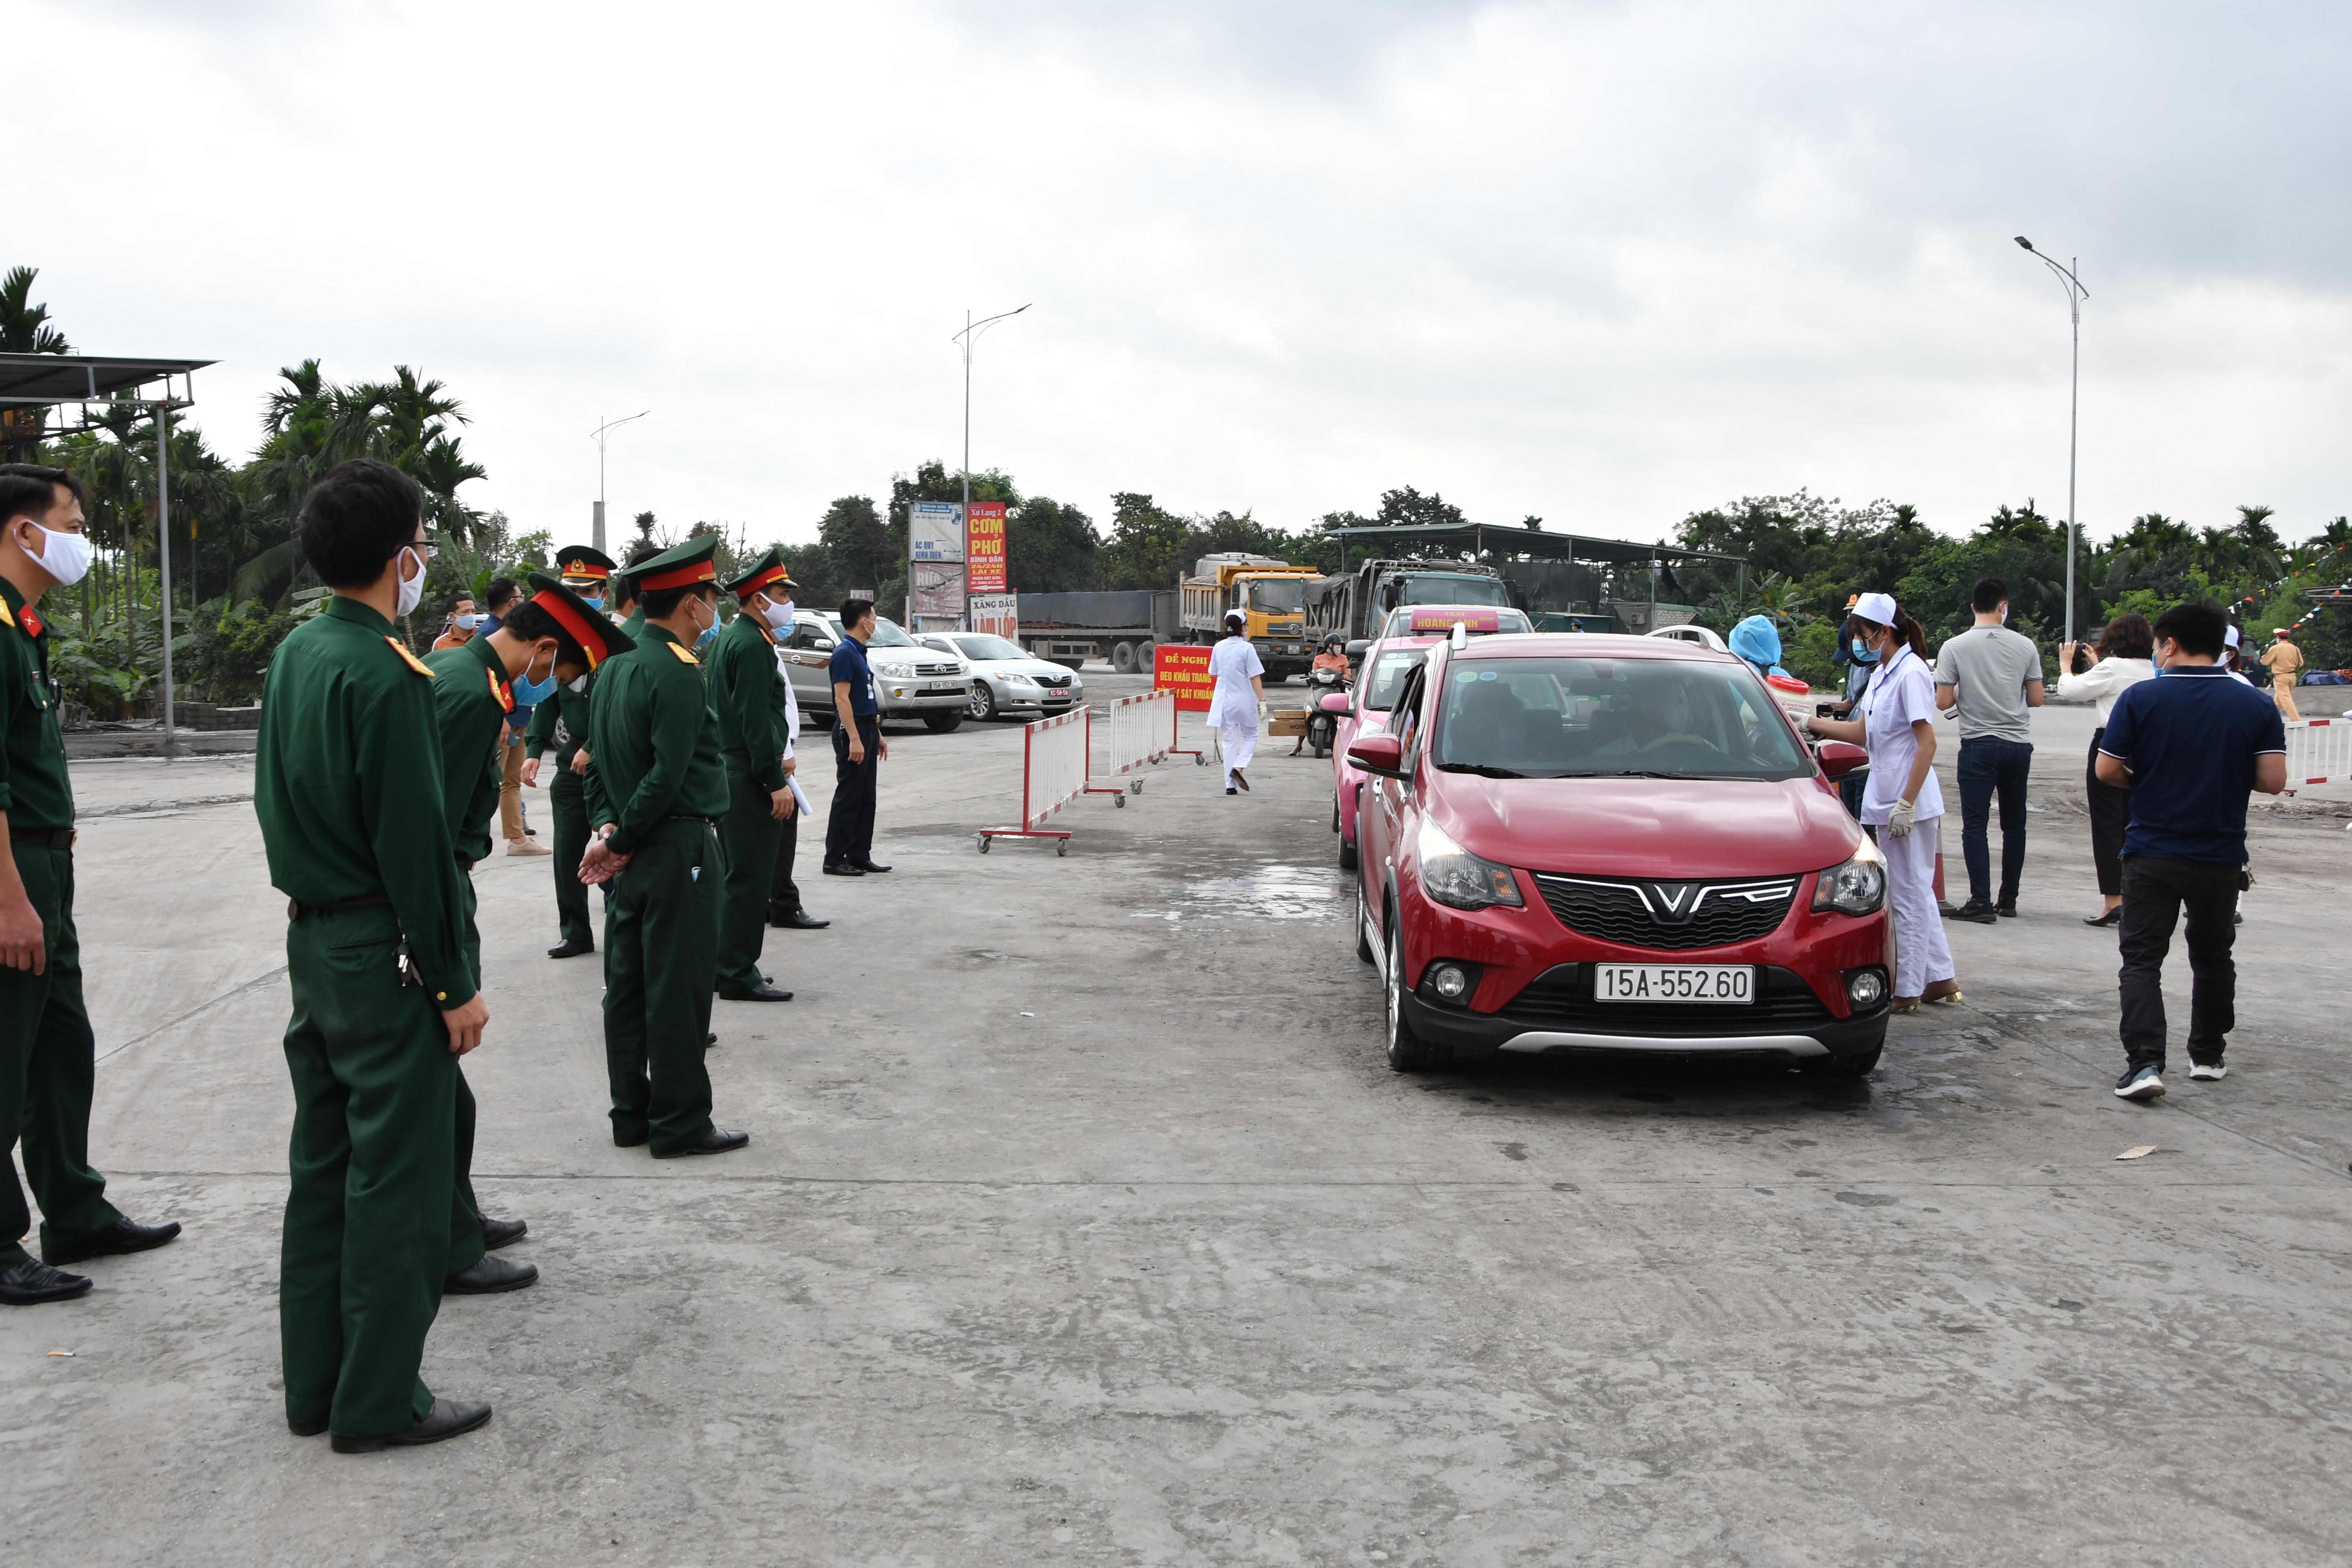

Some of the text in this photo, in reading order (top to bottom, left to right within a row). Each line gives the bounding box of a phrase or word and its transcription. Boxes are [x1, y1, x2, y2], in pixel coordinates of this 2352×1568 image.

[981, 509, 996, 517] Lạng
[970, 518, 1003, 534] CƠM
[924, 541, 934, 550] QUY
[972, 534, 1002, 555] PHỞ
[922, 595, 937, 610] XE
[973, 599, 996, 609] XĂNG
[974, 608, 1016, 639] LÀM LỐP
[1417, 617, 1454, 628] HOÀNG
[1181, 656, 1208, 667] NGHỊ
[1160, 668, 1212, 683] ĐEO KHẨU TRANG
[1181, 687, 1192, 699] SÁT
[1193, 686, 1214, 700] KHUẨN
[1605, 969, 1748, 998] 15A-552.60
